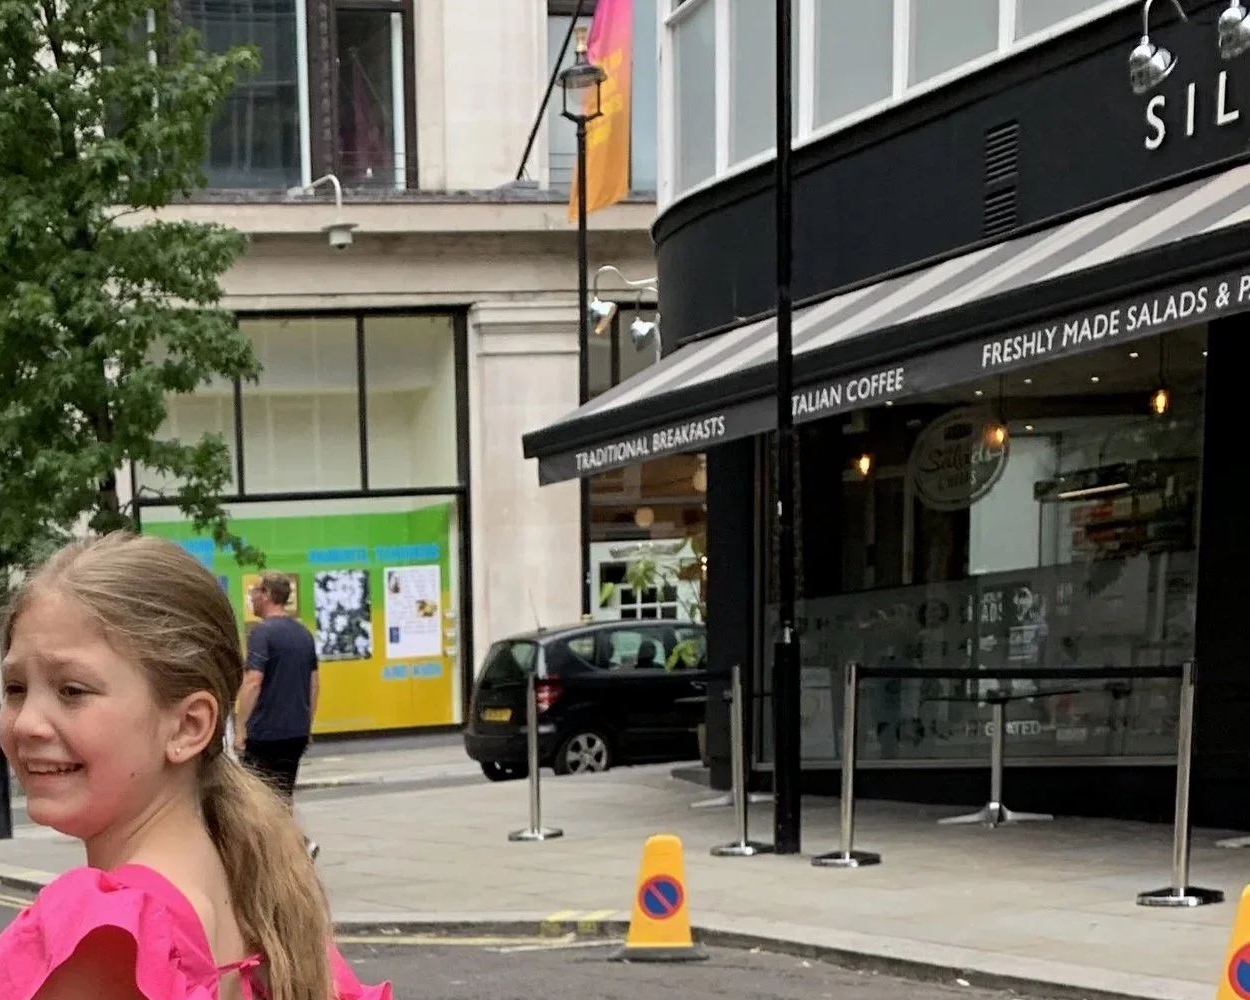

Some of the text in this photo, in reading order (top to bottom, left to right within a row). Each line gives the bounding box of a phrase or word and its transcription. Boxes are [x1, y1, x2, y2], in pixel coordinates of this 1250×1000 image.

[981, 325, 1058, 368] FRESHLY
[1062, 309, 1120, 347] MADE
[1126, 286, 1208, 331] SALADS
[1215, 281, 1230, 308] &
[791, 367, 904, 416] TALIAN COFFEE
[575, 415, 725, 471] TRADITIONAL BREAKFASTS
